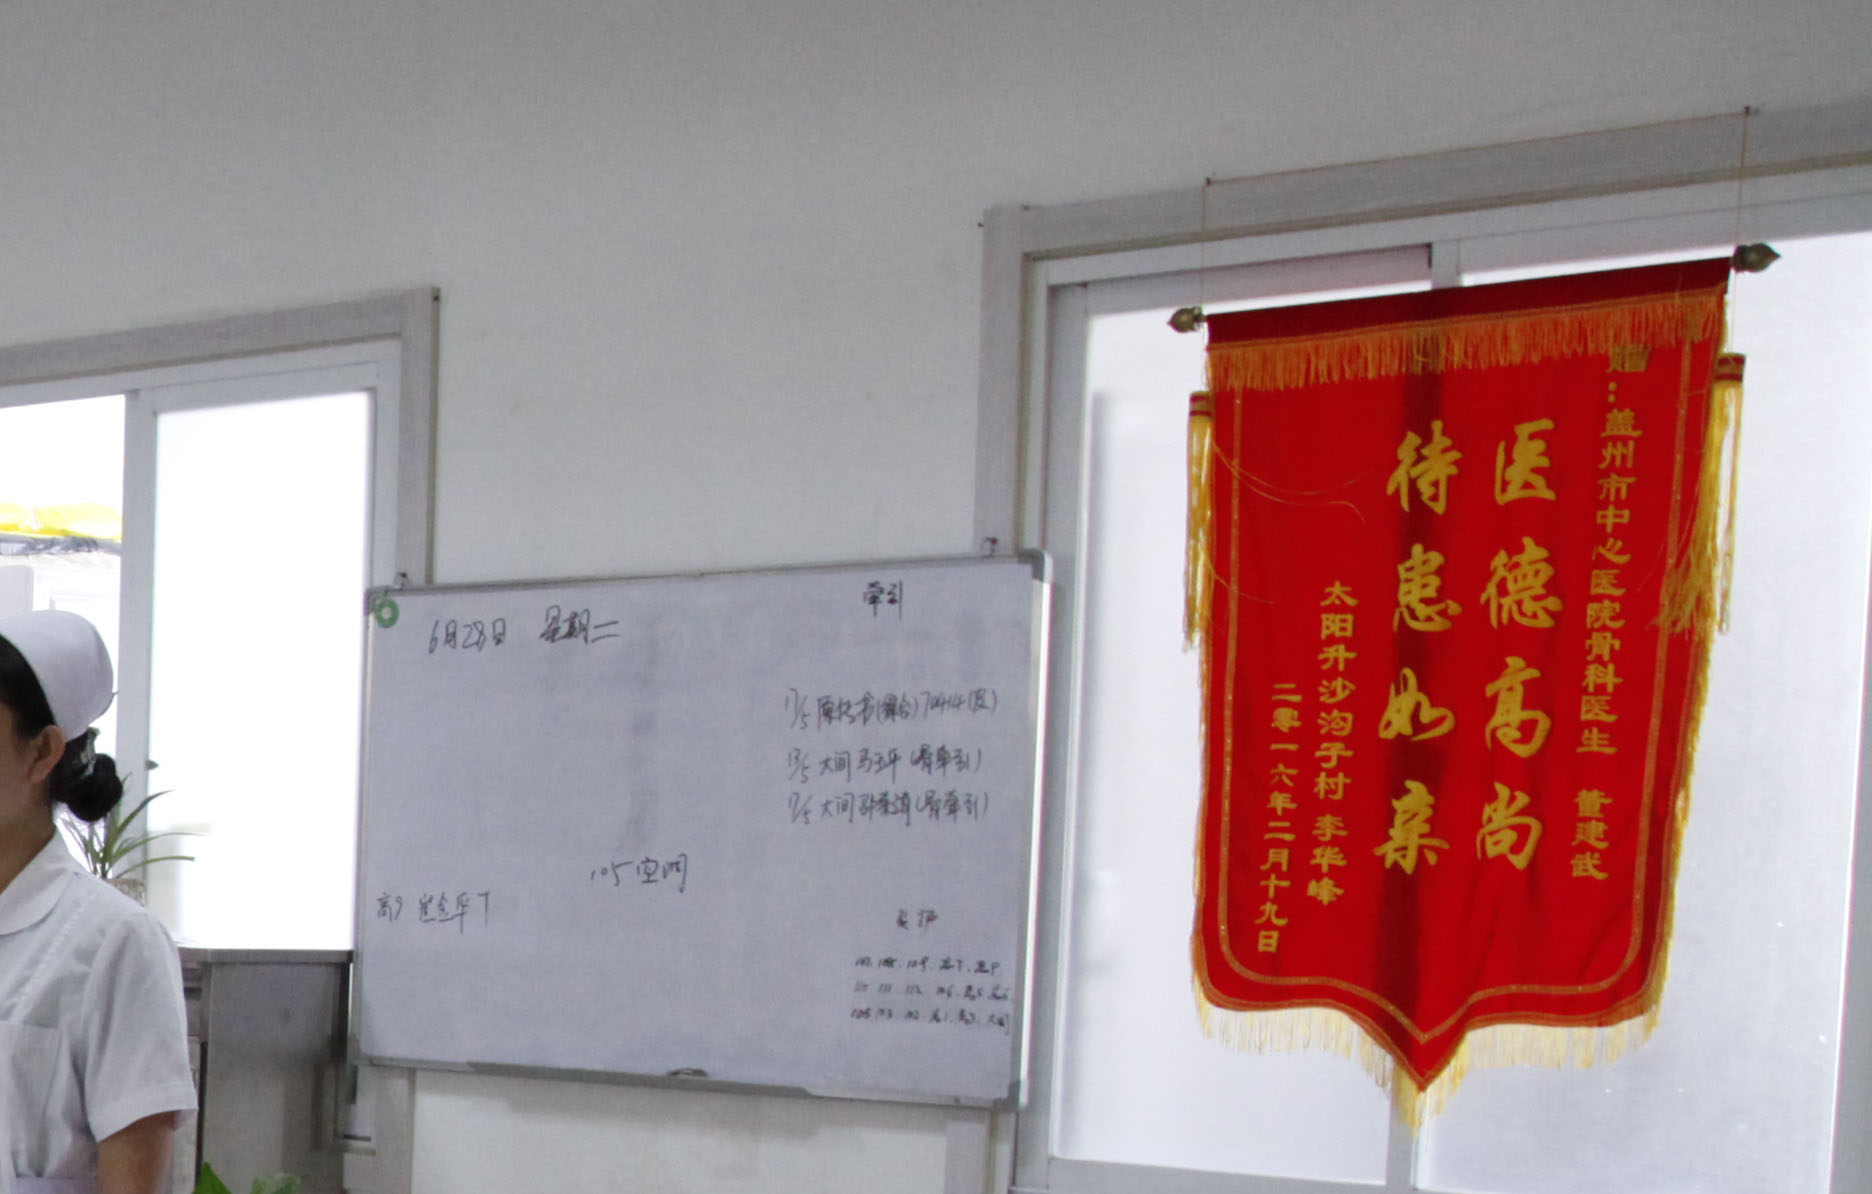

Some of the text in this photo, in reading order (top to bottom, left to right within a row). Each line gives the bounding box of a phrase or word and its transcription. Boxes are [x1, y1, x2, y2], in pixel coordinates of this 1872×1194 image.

[538, 603, 622, 645] 星期二
[1474, 419, 1563, 871] 医德高尚
